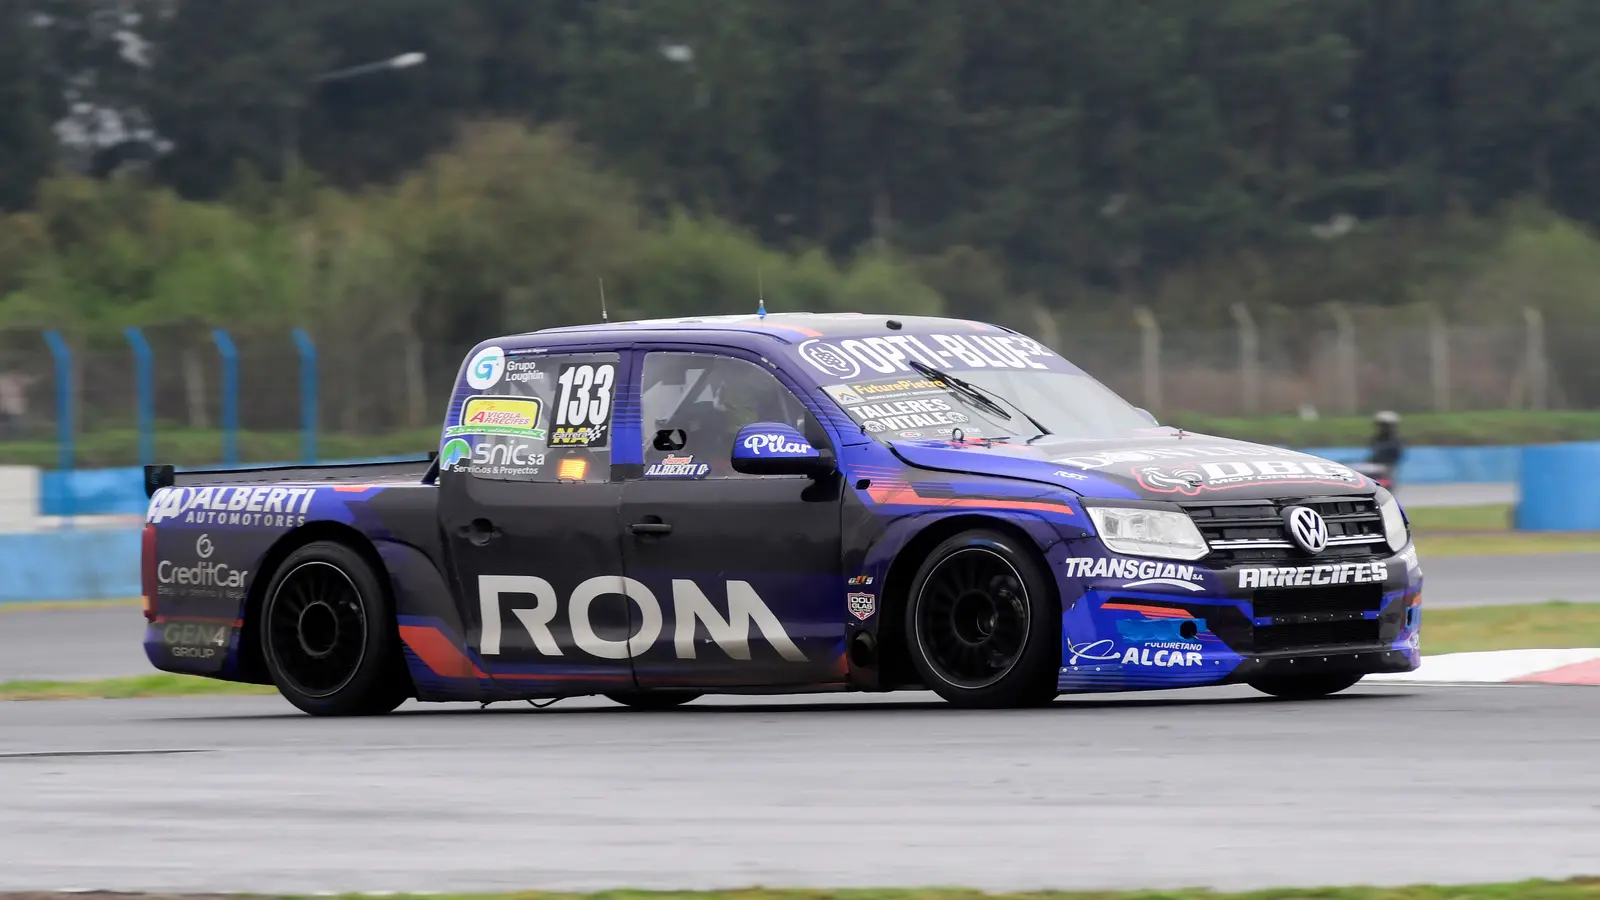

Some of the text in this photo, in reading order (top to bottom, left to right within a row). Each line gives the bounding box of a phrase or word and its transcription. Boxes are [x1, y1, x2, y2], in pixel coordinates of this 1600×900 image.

[505, 370, 544, 383] Loughlin
[507, 360, 536, 372] Grupo
[555, 364, 615, 426] 133
[848, 398, 952, 420] TALLERES
[878, 411, 954, 431] VITALE
[743, 433, 812, 455] Pilar
[453, 465, 539, 475] Servicios & Proyectos
[645, 464, 697, 476] ALBERTI
[188, 487, 317, 515] ALBERTI
[185, 511, 306, 528] AUTOMOTORES
[157, 560, 249, 588] CreditCar
[1065, 557, 1194, 582] TRANSGIAN
[1238, 562, 1388, 588] ARRECIFES
[478, 574, 810, 663] ROM
[164, 623, 227, 647] GEN4
[172, 646, 215, 659] GROUP
[1121, 647, 1203, 668] ALCAR
